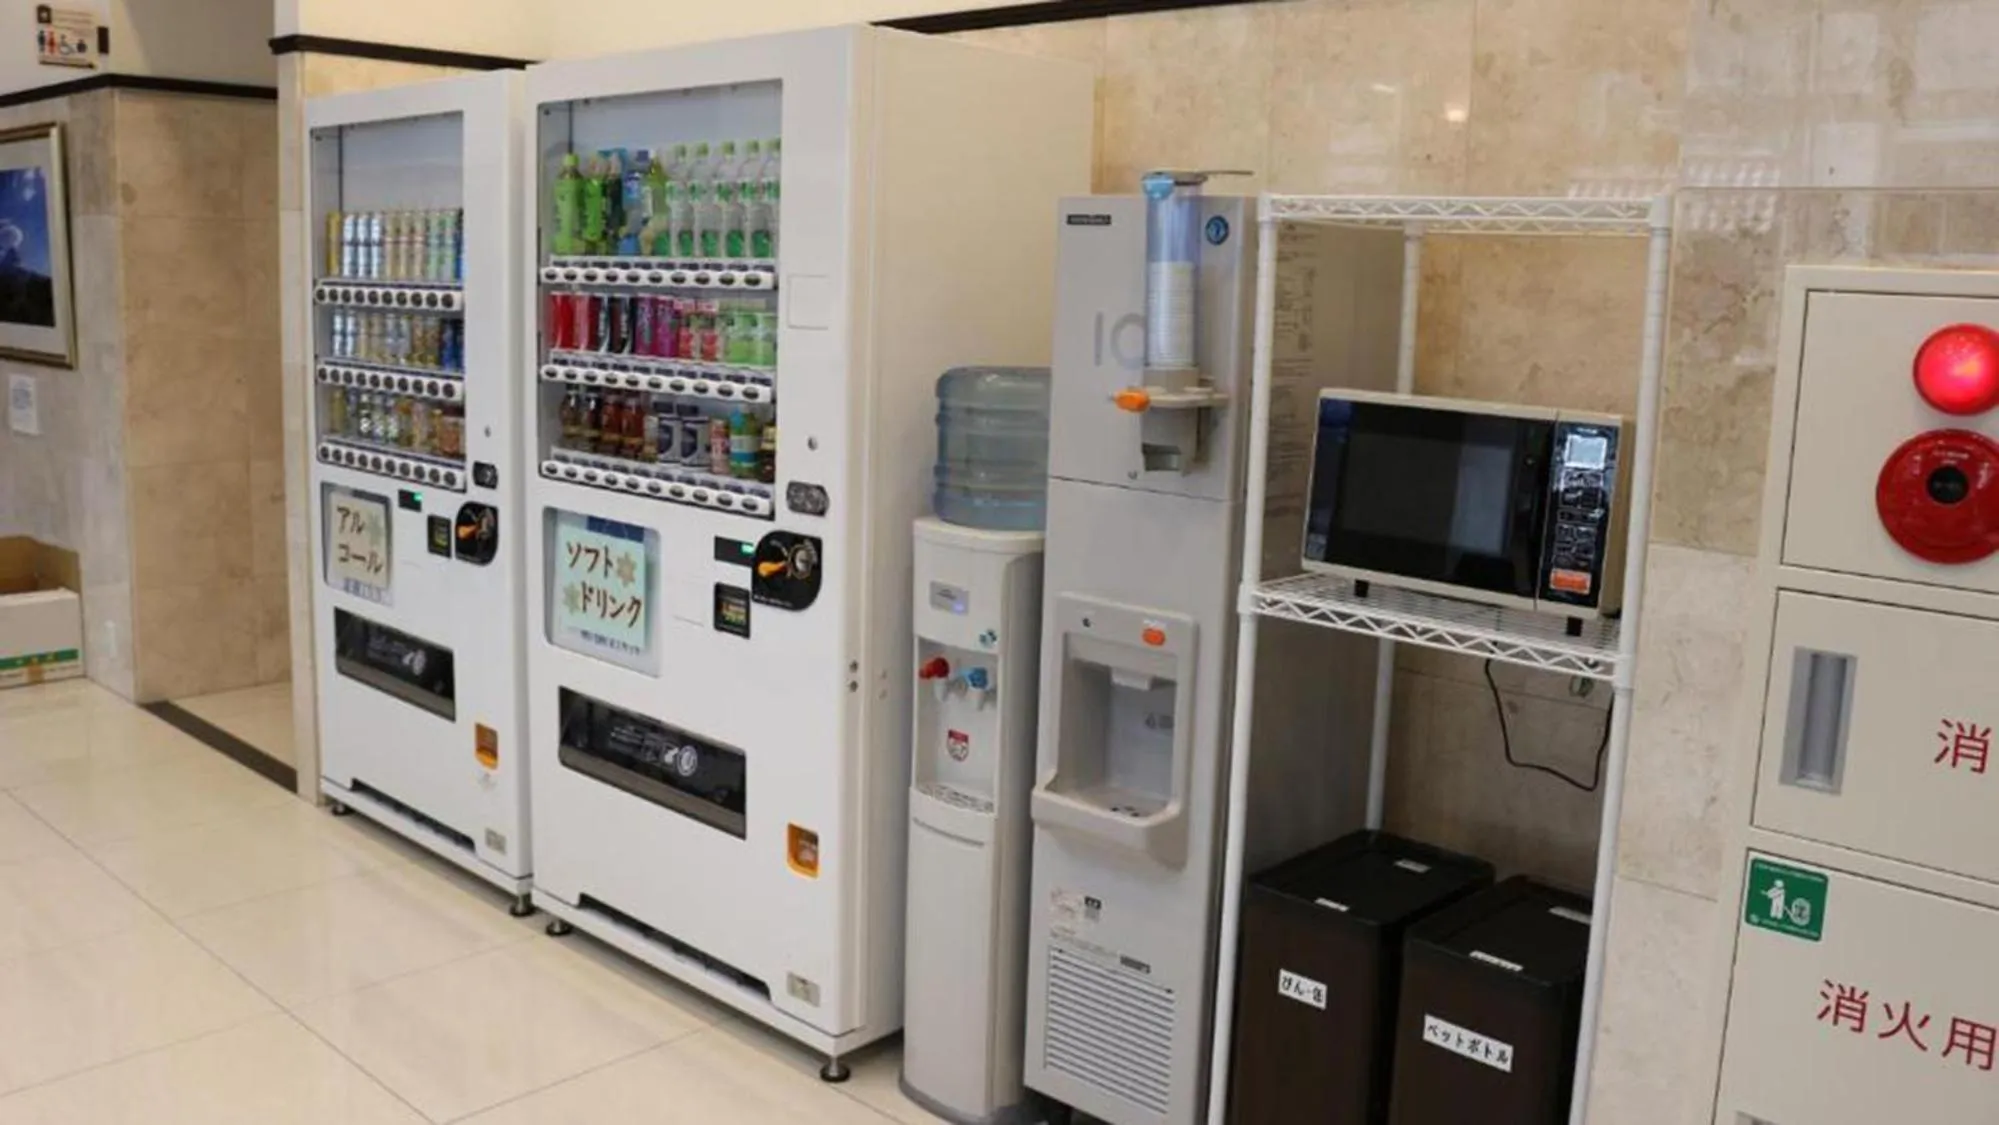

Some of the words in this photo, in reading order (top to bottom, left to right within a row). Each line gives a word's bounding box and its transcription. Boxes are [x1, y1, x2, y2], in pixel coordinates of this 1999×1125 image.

[336, 506, 367, 535] アル
[337, 543, 385, 575] コール
[565, 540, 615, 579] ソフト
[580, 582, 643, 629] ドリンク
[1934, 717, 1992, 775] 消
[1427, 1023, 1509, 1066] ペットボトル
[1816, 978, 1999, 1072] 消火用
